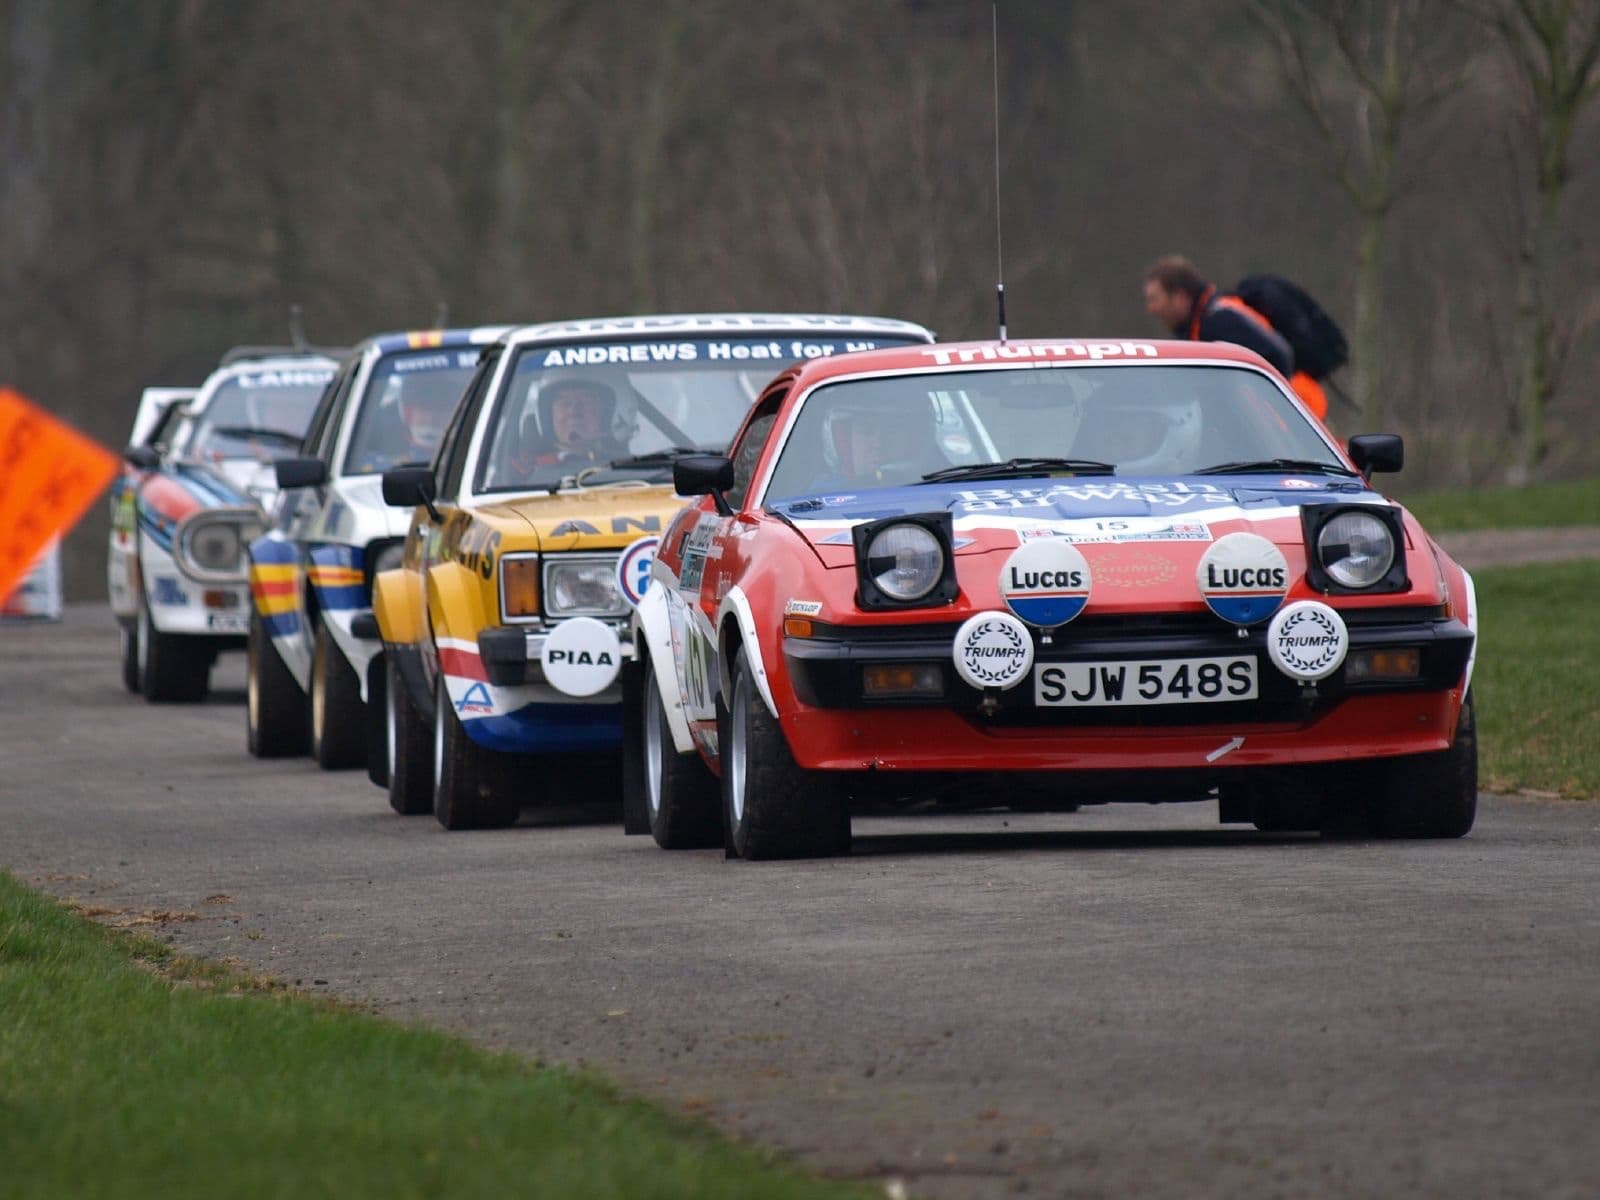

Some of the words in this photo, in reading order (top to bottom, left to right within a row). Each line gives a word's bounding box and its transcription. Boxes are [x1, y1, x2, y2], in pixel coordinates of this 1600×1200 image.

[543, 343, 698, 365] ANDREWS
[708, 343, 783, 360] Heat
[790, 341, 834, 358] for
[922, 342, 1158, 365] Triumph
[1095, 520, 1129, 531] 15
[1011, 566, 1083, 590] Lucas
[1207, 563, 1285, 588] Lucas
[964, 645, 1026, 659] TRIUMPH
[1277, 634, 1340, 647] TRIUMPH
[548, 650, 614, 666] PIAA
[1040, 665, 1126, 702] SJW
[1137, 660, 1251, 699] 548S
